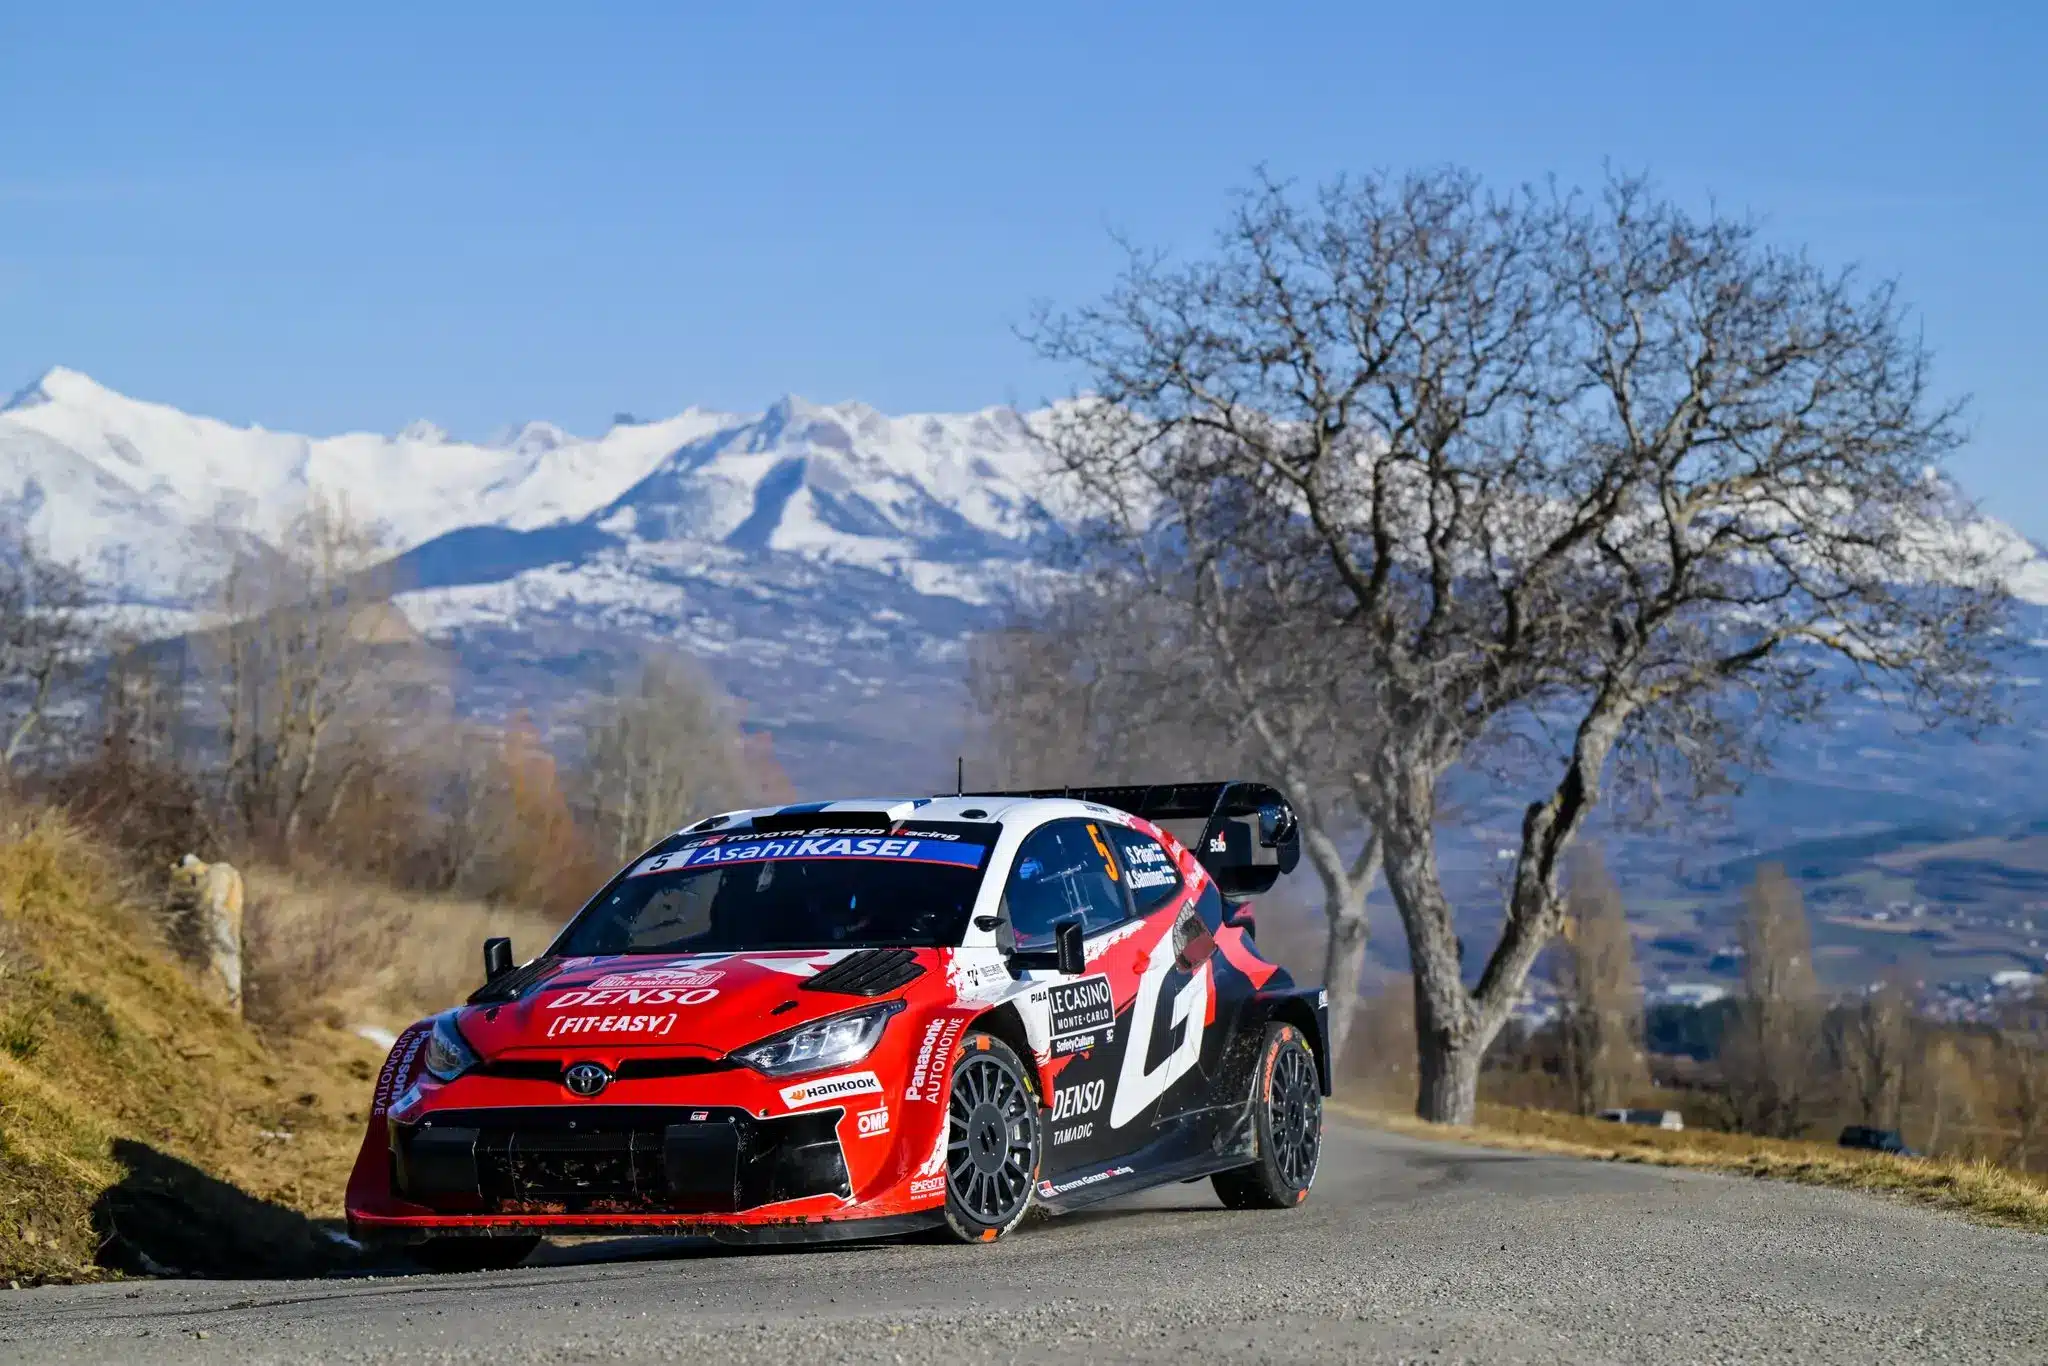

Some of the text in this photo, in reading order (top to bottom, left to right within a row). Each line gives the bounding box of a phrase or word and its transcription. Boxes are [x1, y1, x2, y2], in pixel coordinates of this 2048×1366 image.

[727, 830, 805, 842] TOYOTA
[803, 828, 885, 837] GAZOO
[889, 828, 960, 841] Racing
[649, 853, 669, 871] 5
[1086, 824, 1119, 881] 5
[546, 988, 720, 1009] DENSO
[1030, 991, 1047, 1003] PIAA
[1050, 981, 1109, 1014] LE CASINO
[905, 1018, 945, 1101] Panasonic
[1056, 1035, 1095, 1053] SafetyCulture
[374, 1030, 415, 1116] AUTOMOTIVE
[391, 1030, 432, 1100] Panasoni
[926, 1018, 965, 1104] AUTOMOTIVE
[1051, 1079, 1105, 1122] DENSO
[857, 1112, 889, 1133] OMP
